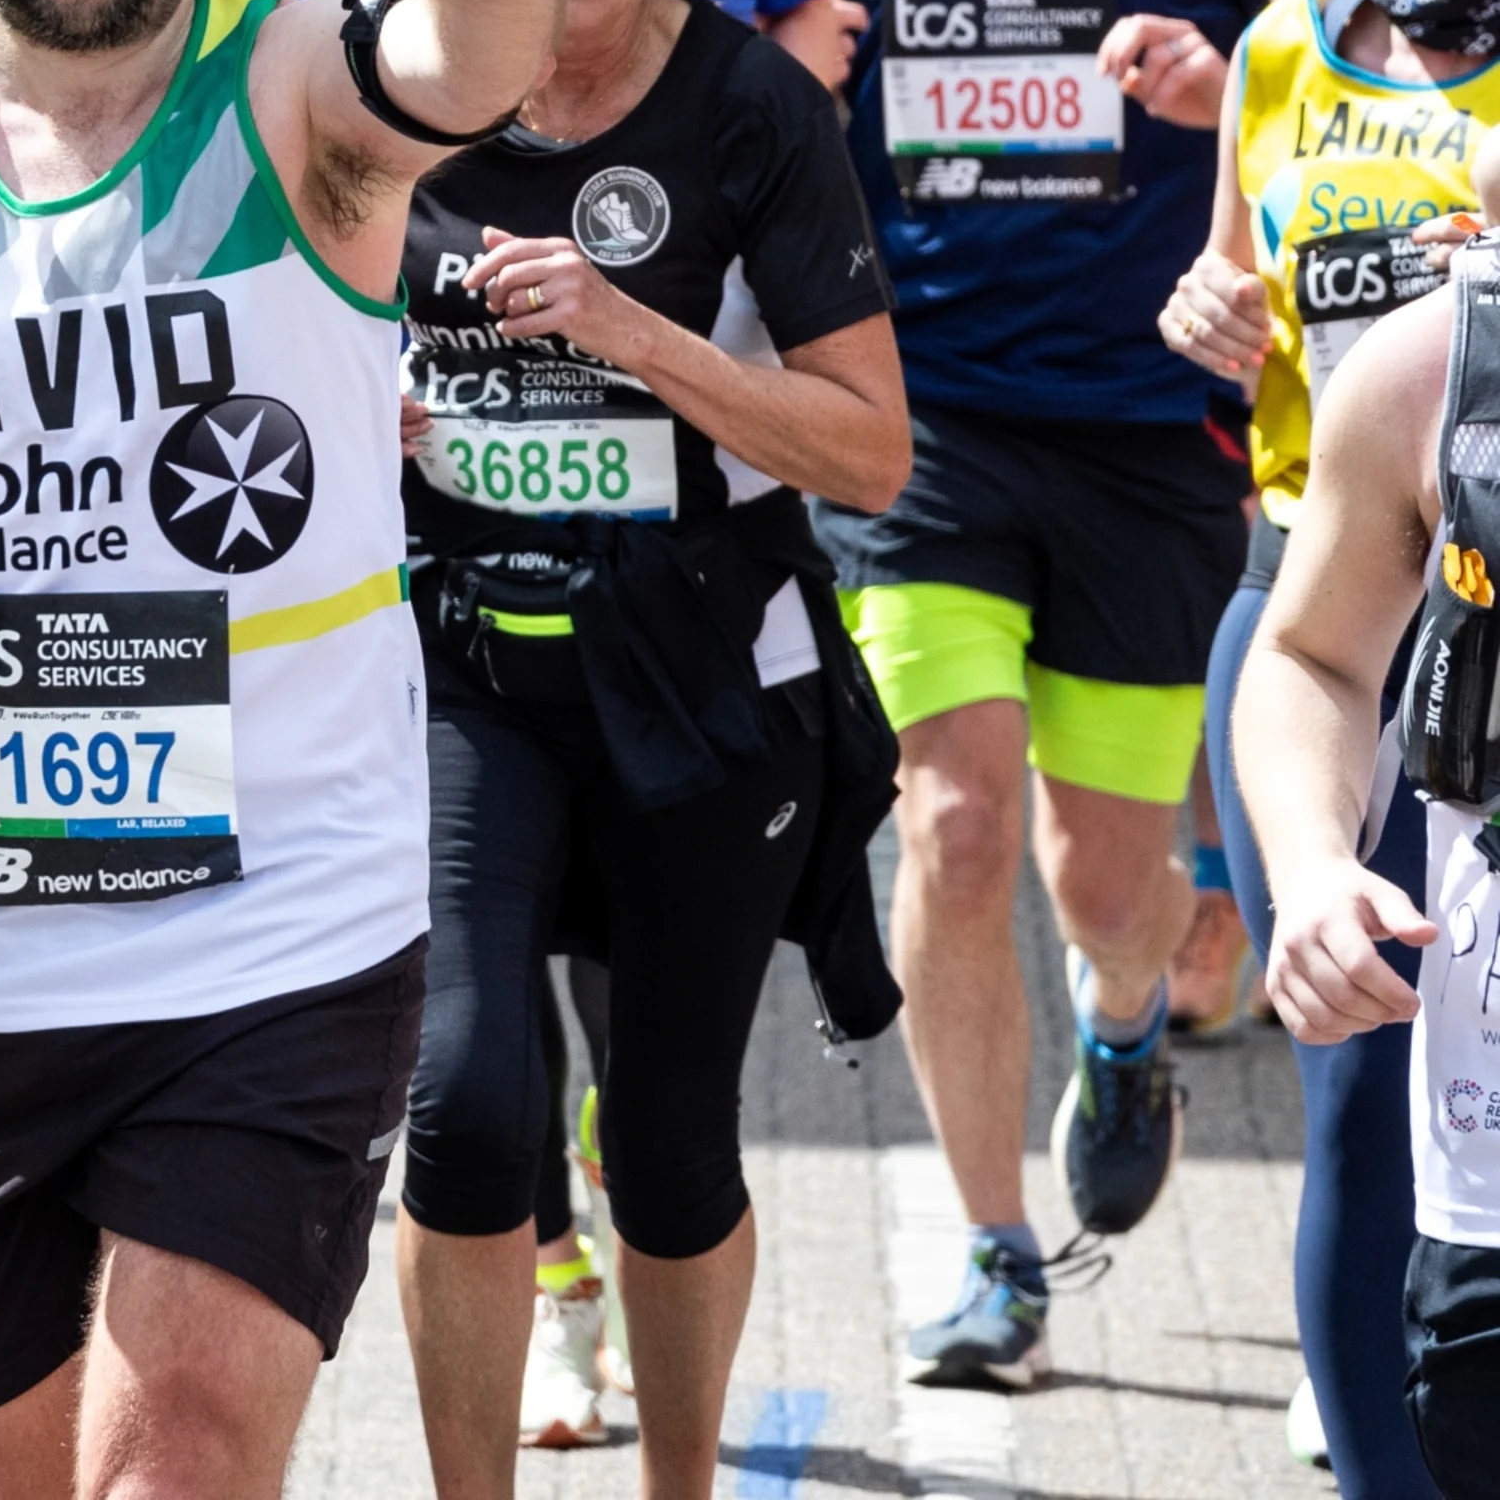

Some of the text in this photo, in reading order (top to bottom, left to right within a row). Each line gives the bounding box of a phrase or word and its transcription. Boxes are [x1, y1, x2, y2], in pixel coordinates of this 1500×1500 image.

[982, 8, 1103, 28] CONSULTANCY
[983, 28, 1063, 46] SERVICES
[924, 76, 1083, 132] 12508
[1293, 101, 1472, 164] LAURA
[1305, 250, 1387, 309] tcs
[424, 361, 511, 412] tcs
[520, 389, 605, 408] SERVICES
[446, 438, 631, 502] 36858
[36, 613, 110, 634] TATA
[36, 637, 208, 661] CONSULTANCY
[37, 665, 146, 687] SERVICES
[1424, 638, 1452, 737] AONIJIE
[141, 818, 187, 828] RELAXED
[38, 865, 211, 894] new balance
